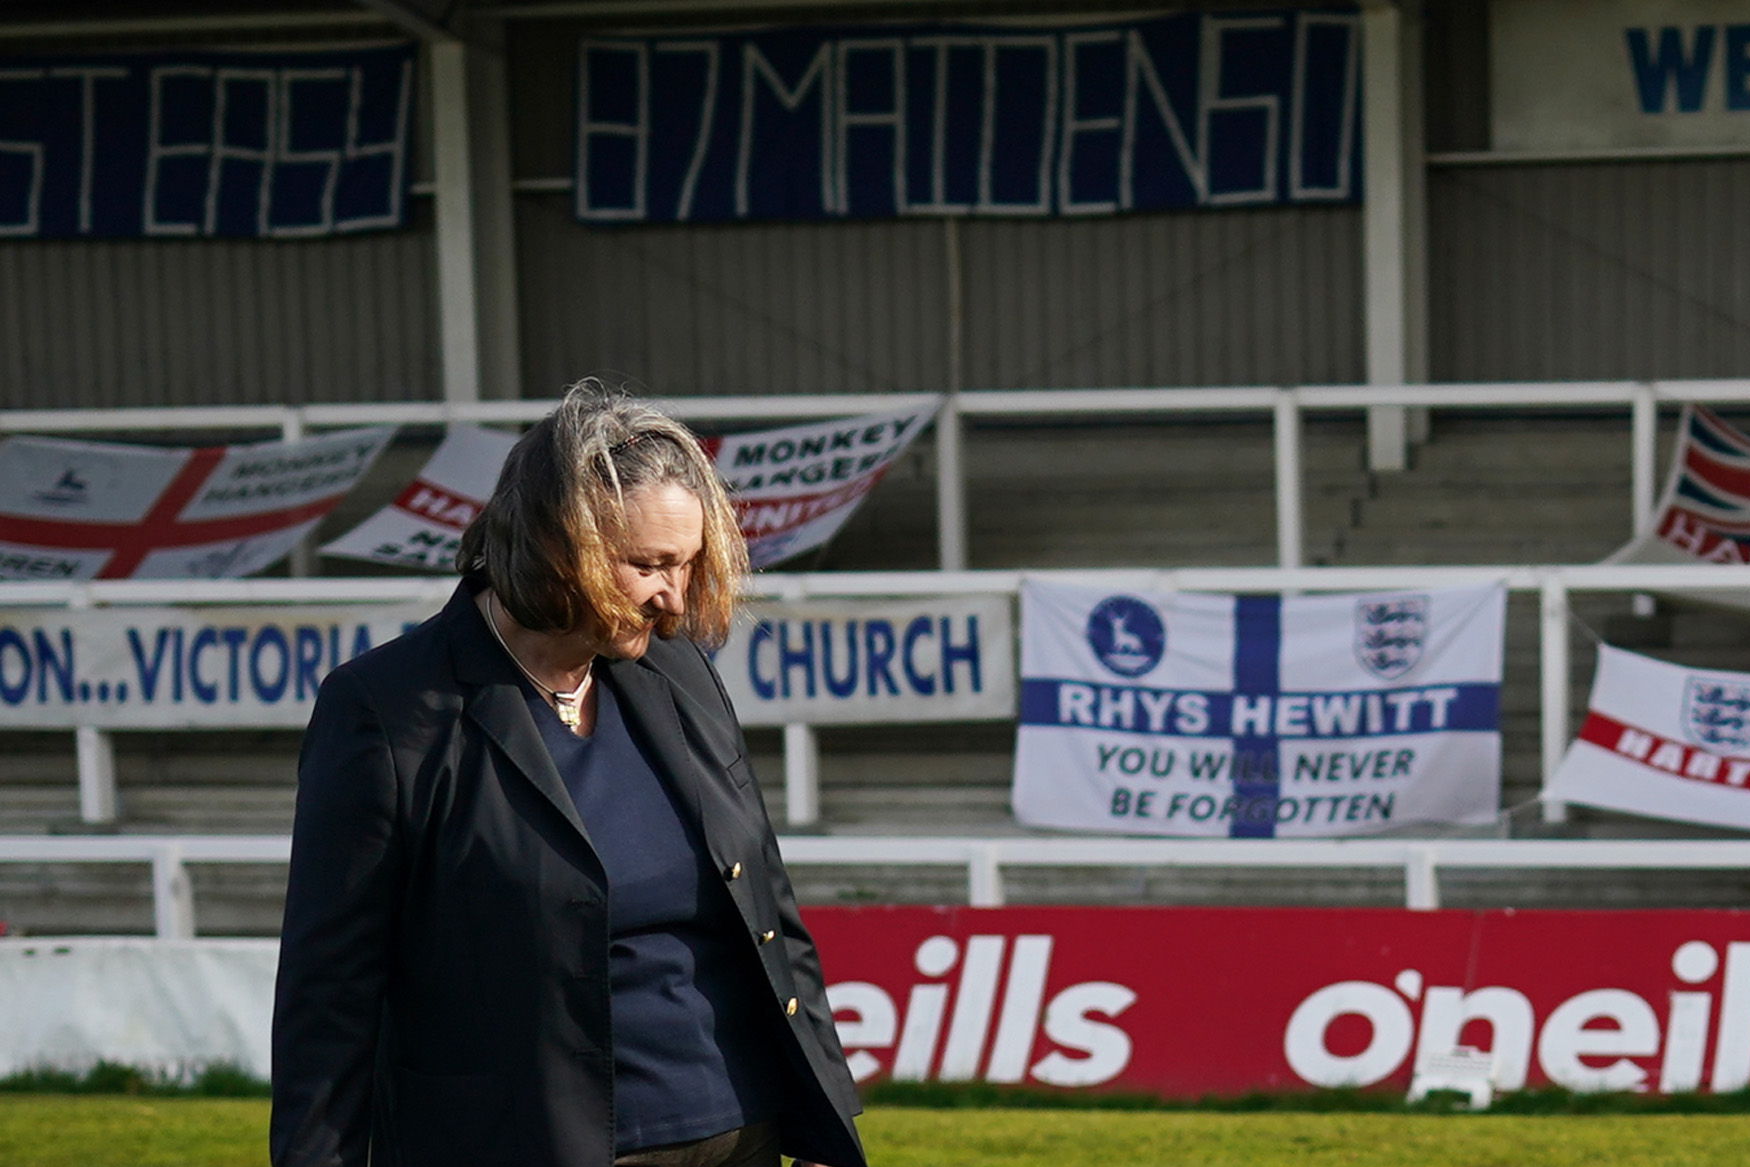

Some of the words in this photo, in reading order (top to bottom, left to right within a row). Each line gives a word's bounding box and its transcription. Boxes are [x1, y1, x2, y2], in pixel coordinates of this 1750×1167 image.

[733, 414, 917, 468] MONKEY
[747, 615, 983, 701] CHURCH
[1057, 683, 1210, 735] RHYS
[1231, 688, 1458, 737] HEWITT
[1098, 743, 1176, 779] YOU
[1189, 751, 1282, 781] WILL
[1293, 747, 1417, 783] NEVER
[1110, 788, 1152, 819] BE
[1166, 792, 1395, 825] FORGOTTEN
